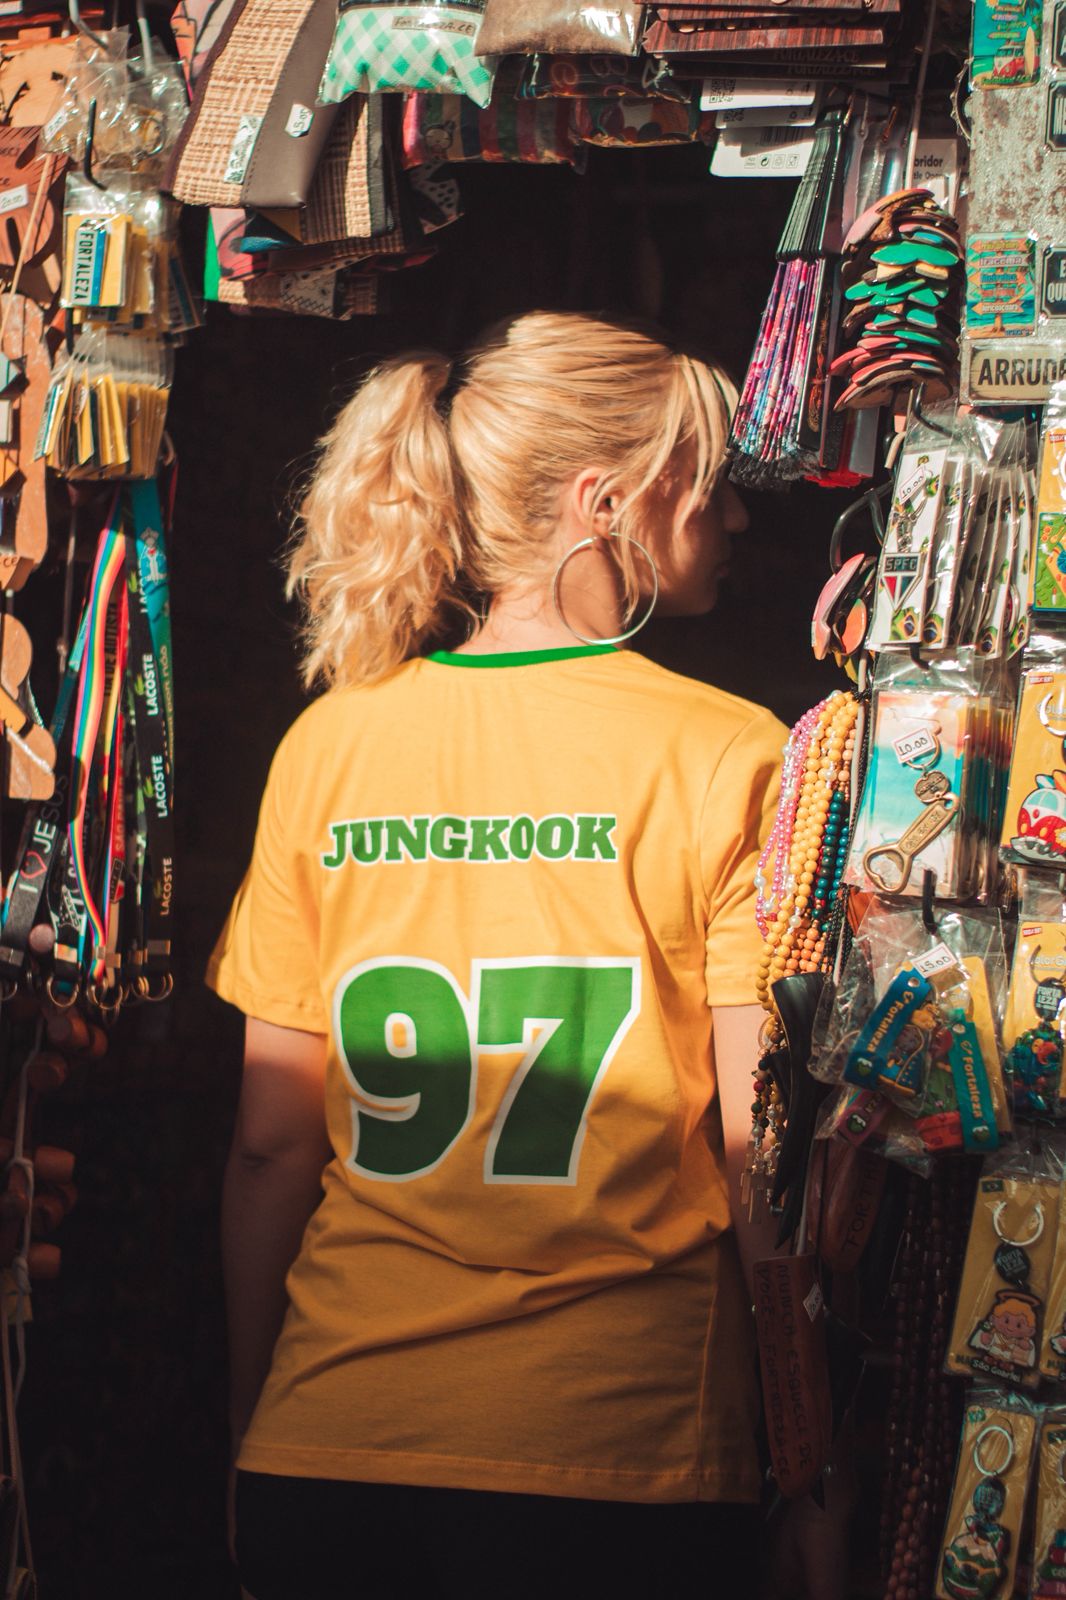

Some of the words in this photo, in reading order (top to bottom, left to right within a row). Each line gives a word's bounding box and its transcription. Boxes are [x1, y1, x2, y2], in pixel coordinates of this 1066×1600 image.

[73, 231, 95, 301] FORTALEZA
[884, 558, 918, 573] SPFC
[142, 652, 160, 718] LACOSTE
[897, 736, 929, 757] 10.00
[150, 753, 169, 819] LACOSTE
[321, 813, 619, 869] JUNGKOOK
[159, 855, 174, 917] LACOSTE
[919, 955, 951, 974] 15.00
[867, 1001, 905, 1053] Fortaleza
[333, 954, 642, 1187] 97
[961, 1056, 984, 1118] Fortaleza
